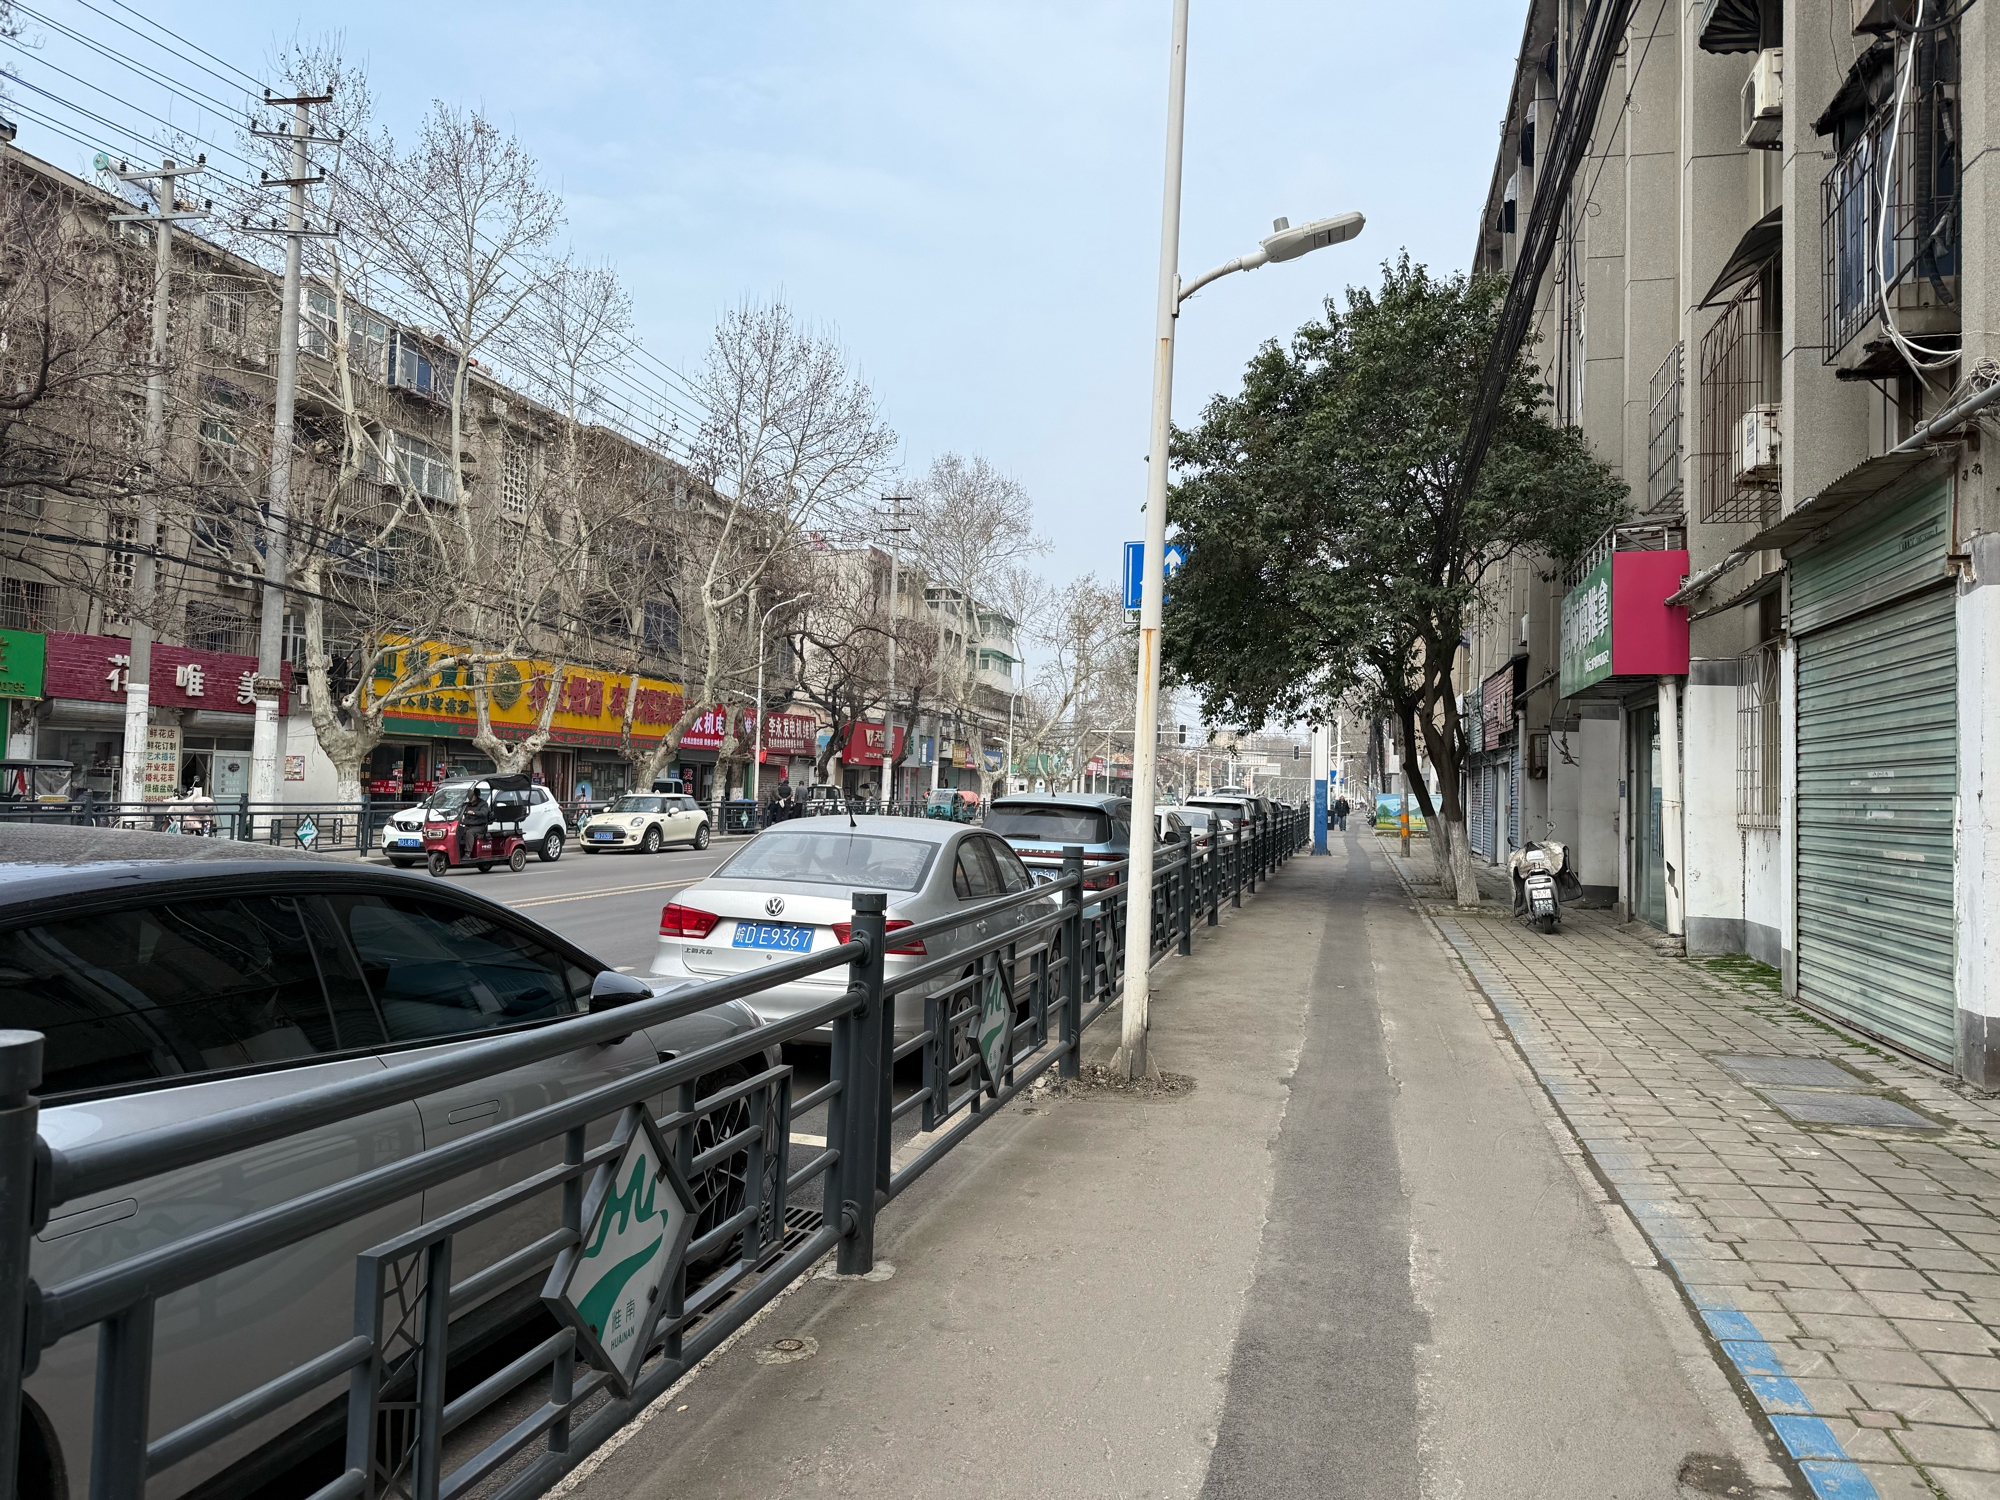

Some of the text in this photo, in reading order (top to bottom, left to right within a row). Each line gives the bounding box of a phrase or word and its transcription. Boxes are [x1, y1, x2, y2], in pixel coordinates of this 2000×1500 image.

[0, 681, 26, 692] 2795
[149, 728, 176, 739] 鲜花店
[146, 741, 177, 751] 鲜花订制
[146, 752, 176, 761] 艺术插花
[146, 762, 176, 772] 开业花篮
[144, 773, 175, 783] 婚礼花车
[612, 1299, 635, 1334] 淮南
[611, 1325, 635, 1351] HUAINAN
